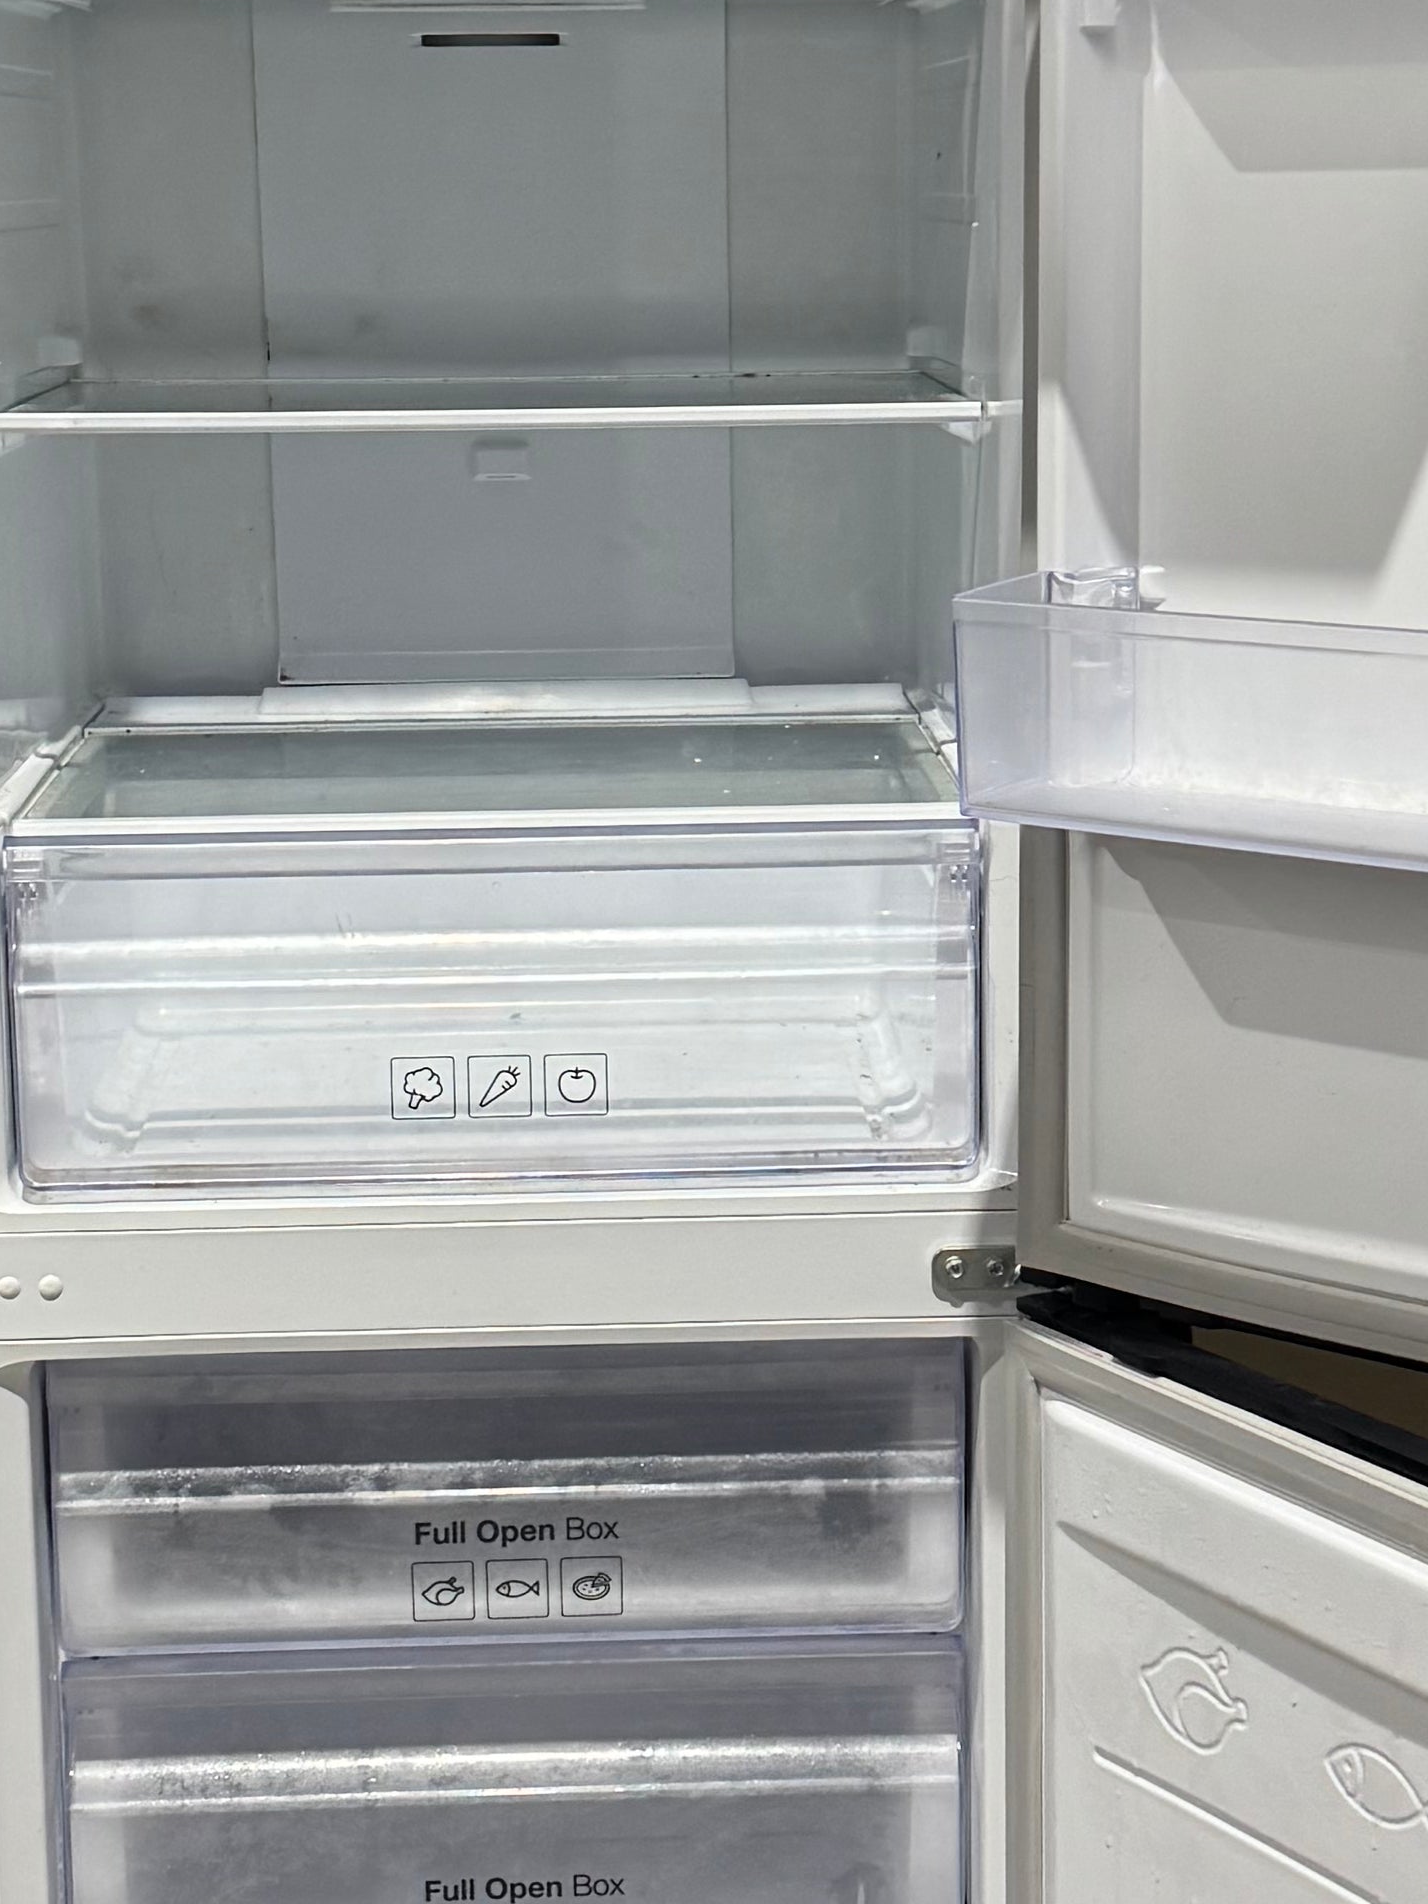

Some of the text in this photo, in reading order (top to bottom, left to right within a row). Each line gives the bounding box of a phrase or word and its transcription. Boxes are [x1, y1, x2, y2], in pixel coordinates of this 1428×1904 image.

[414, 1516, 620, 1548] Full Open Box
[424, 1873, 626, 1904] Full Open Box
